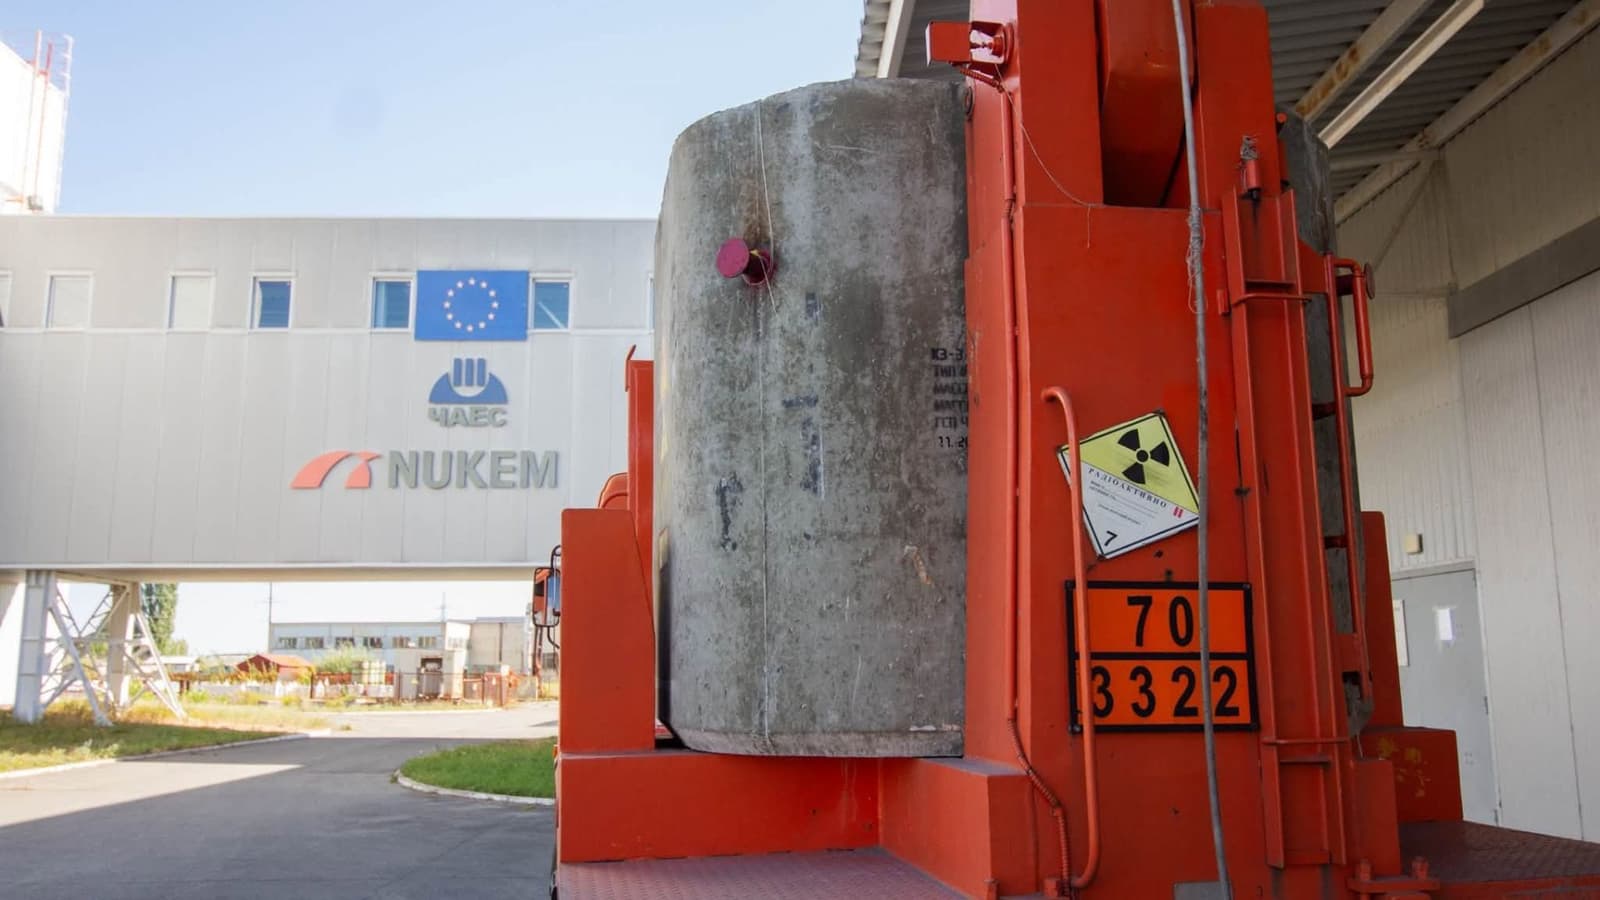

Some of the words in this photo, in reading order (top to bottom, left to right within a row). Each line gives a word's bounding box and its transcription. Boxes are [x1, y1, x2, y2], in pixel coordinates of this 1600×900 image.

[429, 407, 507, 428] ЧАЕС
[388, 450, 559, 490] NUKEM
[1104, 530, 1118, 546] 7
